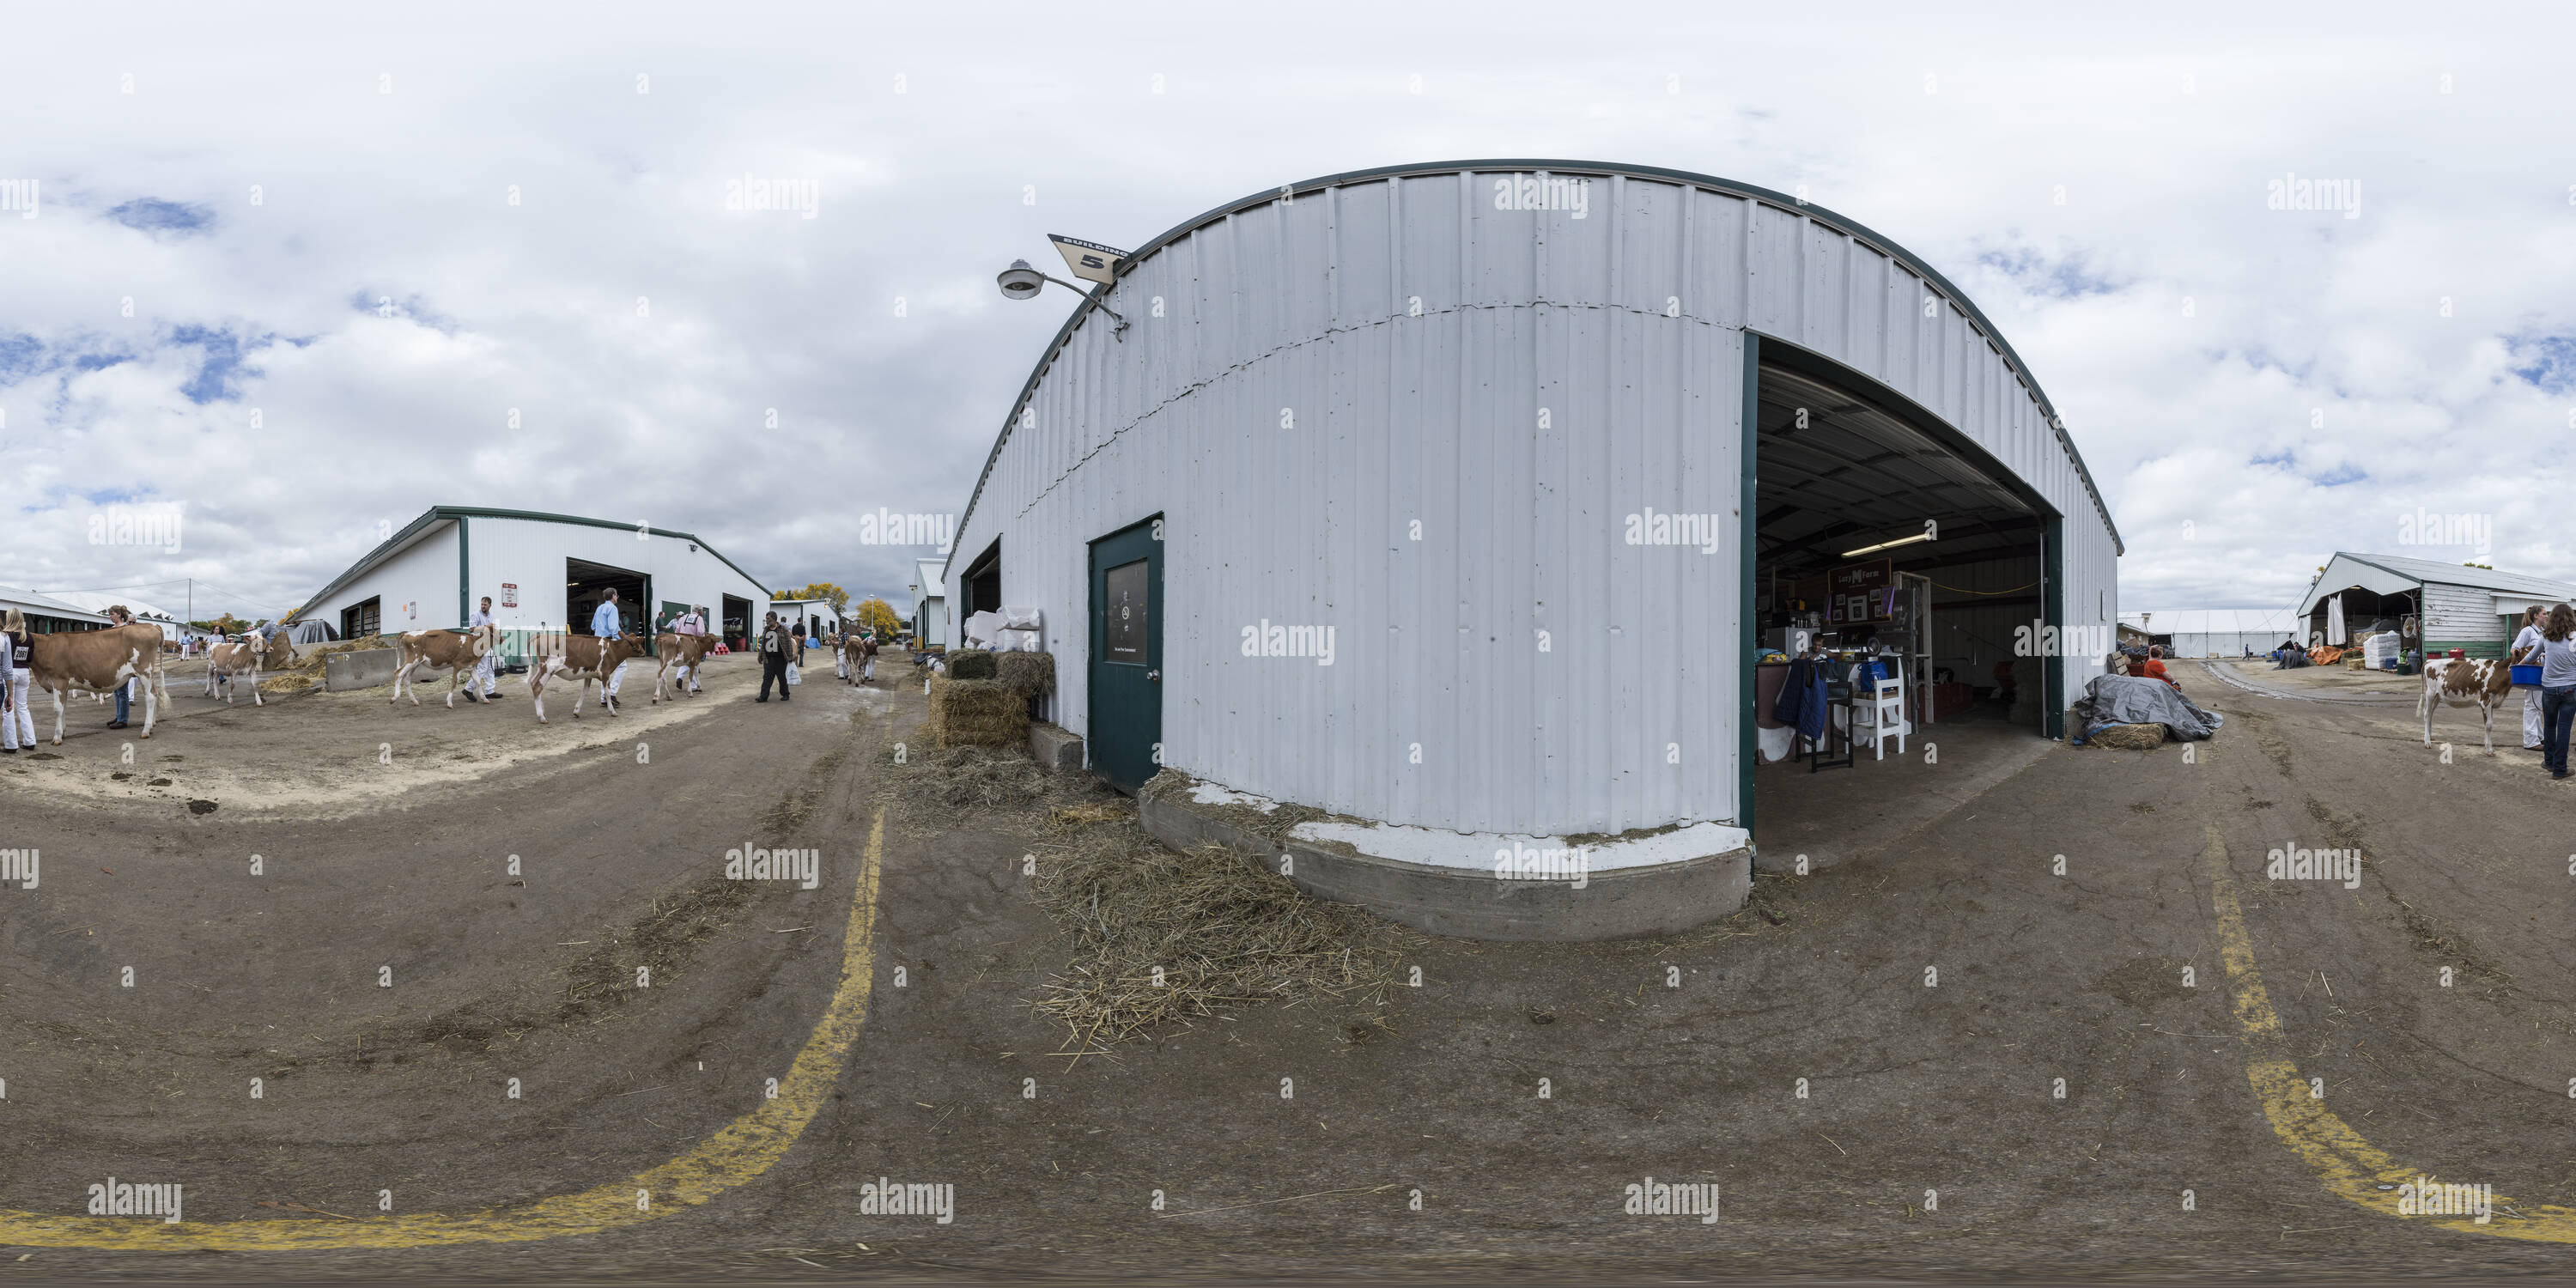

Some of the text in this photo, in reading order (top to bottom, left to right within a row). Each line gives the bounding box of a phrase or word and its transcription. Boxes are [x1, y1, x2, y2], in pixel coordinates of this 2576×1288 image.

[1063, 238, 1128, 257] BUILDING
[1080, 254, 1104, 269] 5
[1852, 569, 1862, 584] M
